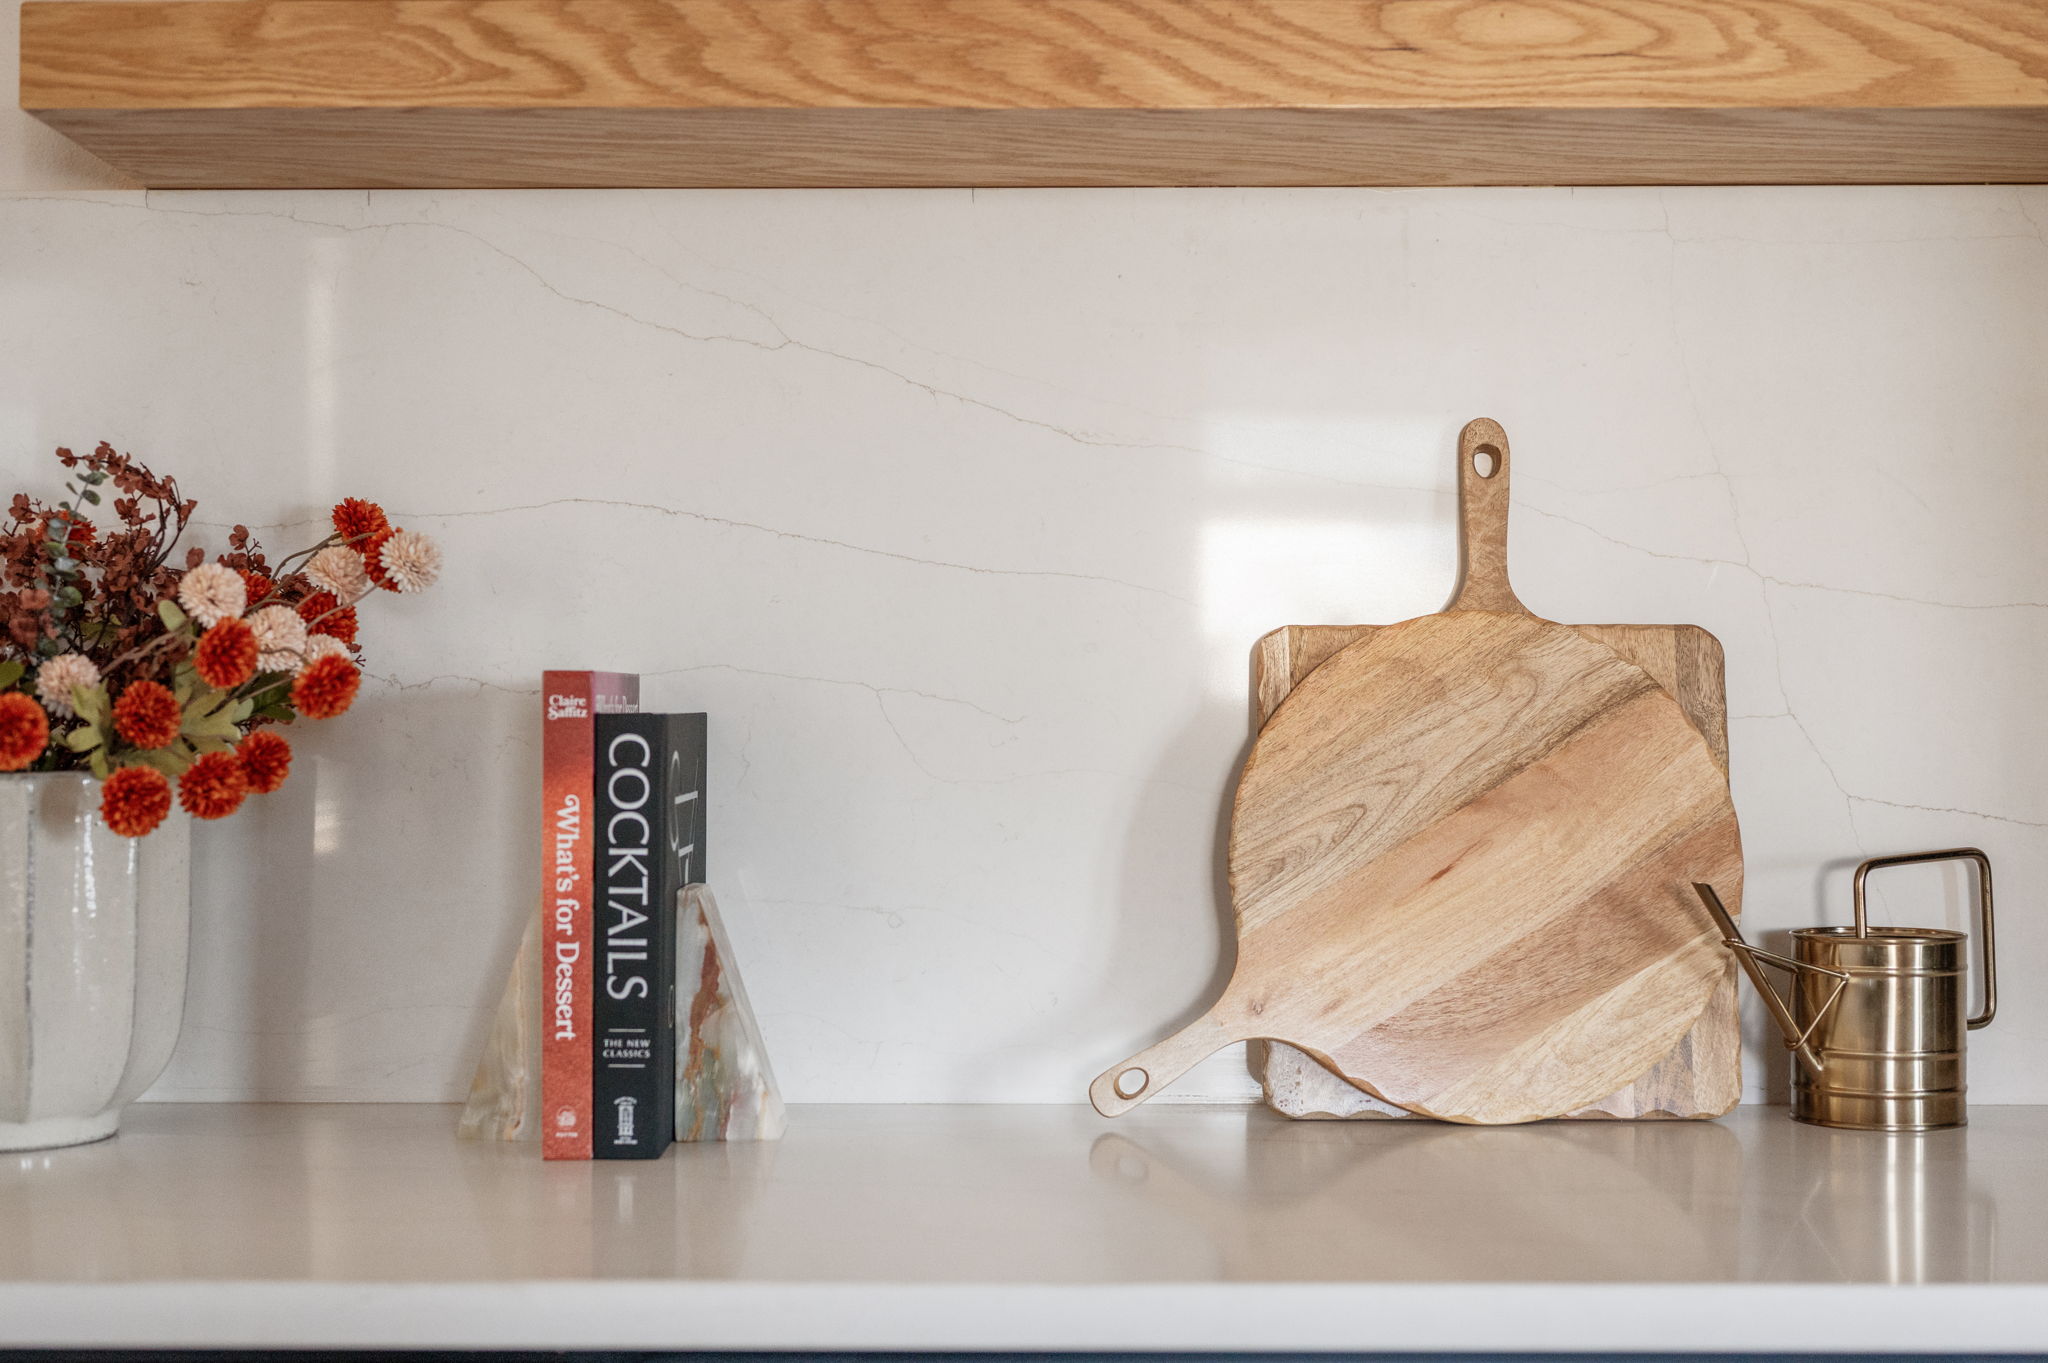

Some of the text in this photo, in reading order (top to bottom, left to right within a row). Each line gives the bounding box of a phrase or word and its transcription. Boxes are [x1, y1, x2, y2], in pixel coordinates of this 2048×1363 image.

[549, 694, 586, 707] Claire
[548, 706, 588, 720] Saffitz
[607, 733, 650, 1000] COCKTAILS
[555, 794, 580, 1041] What's for Dessert
[603, 1038, 651, 1048] THE NEW
[602, 1049, 651, 1059] CLASSICS
